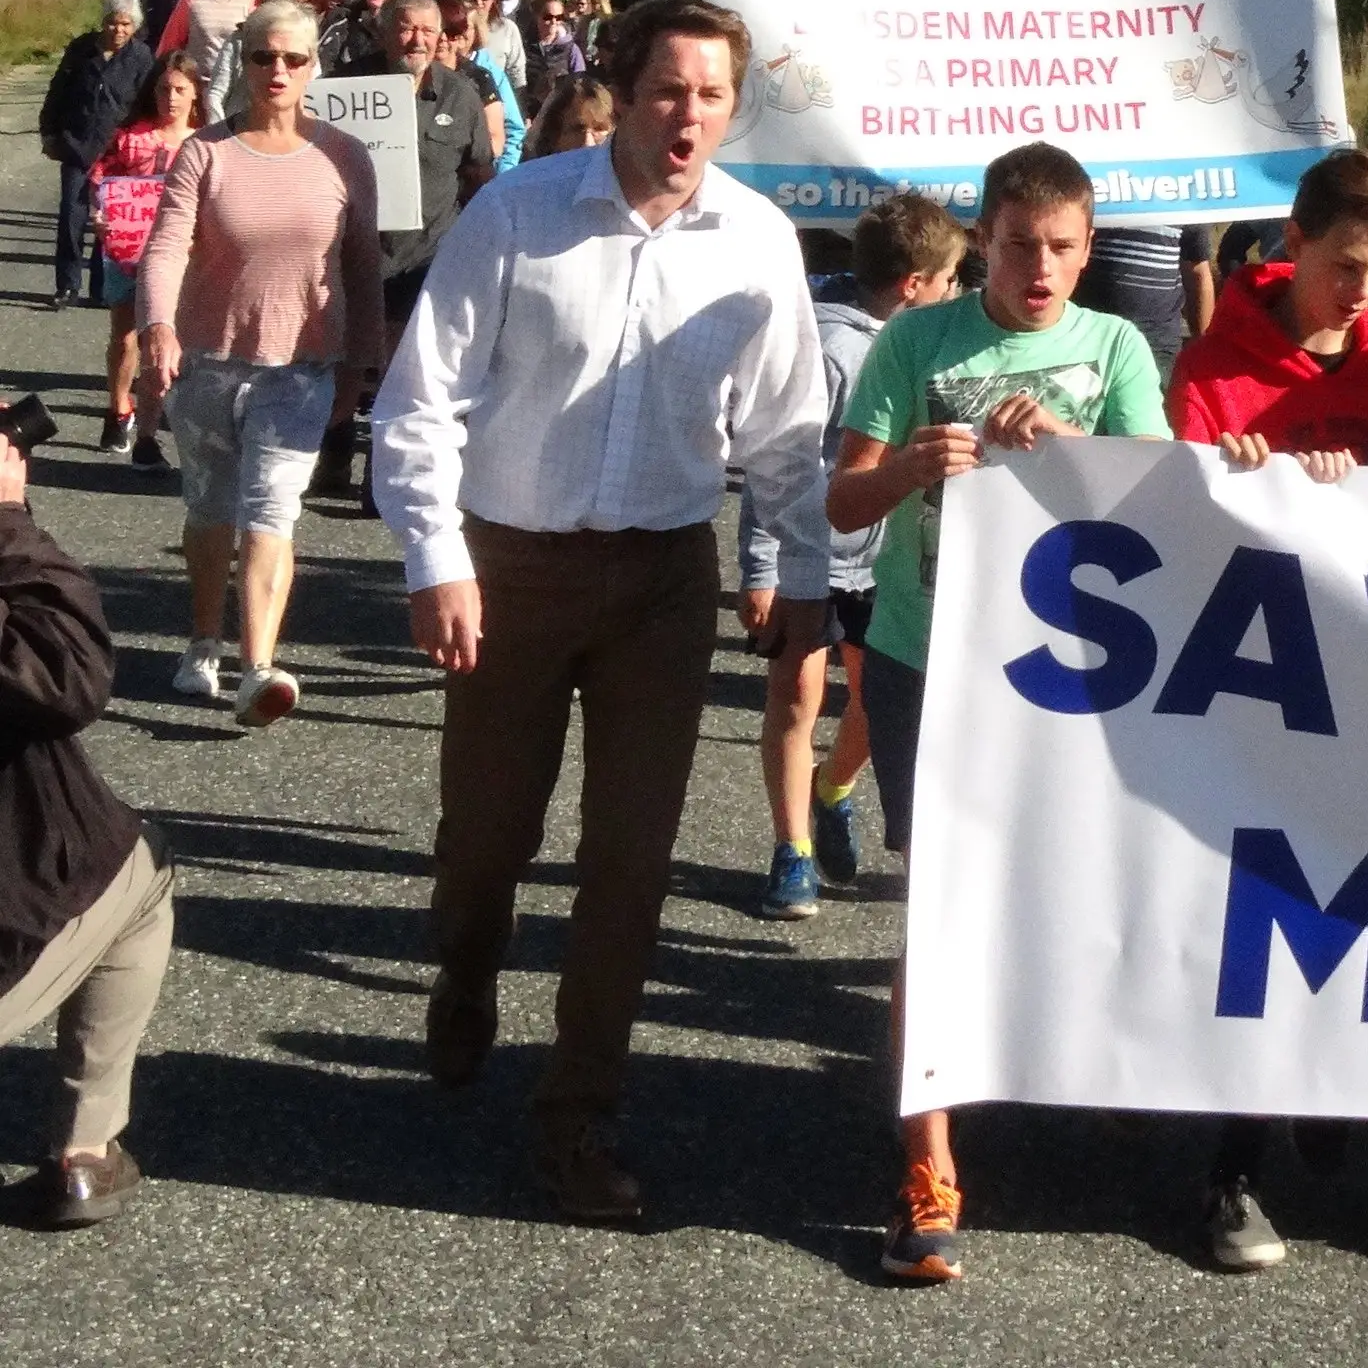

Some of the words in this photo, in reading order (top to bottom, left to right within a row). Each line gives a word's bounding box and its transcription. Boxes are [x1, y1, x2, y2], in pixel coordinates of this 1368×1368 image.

[984, 3, 1205, 40] MATERNITY
[946, 56, 1119, 87] PRIMARY
[861, 104, 1046, 135] BIRTHING
[1055, 101, 1146, 133] UNIT
[777, 181, 823, 207] so
[917, 182, 978, 208] we
[1093, 167, 1237, 203] eliver!!!
